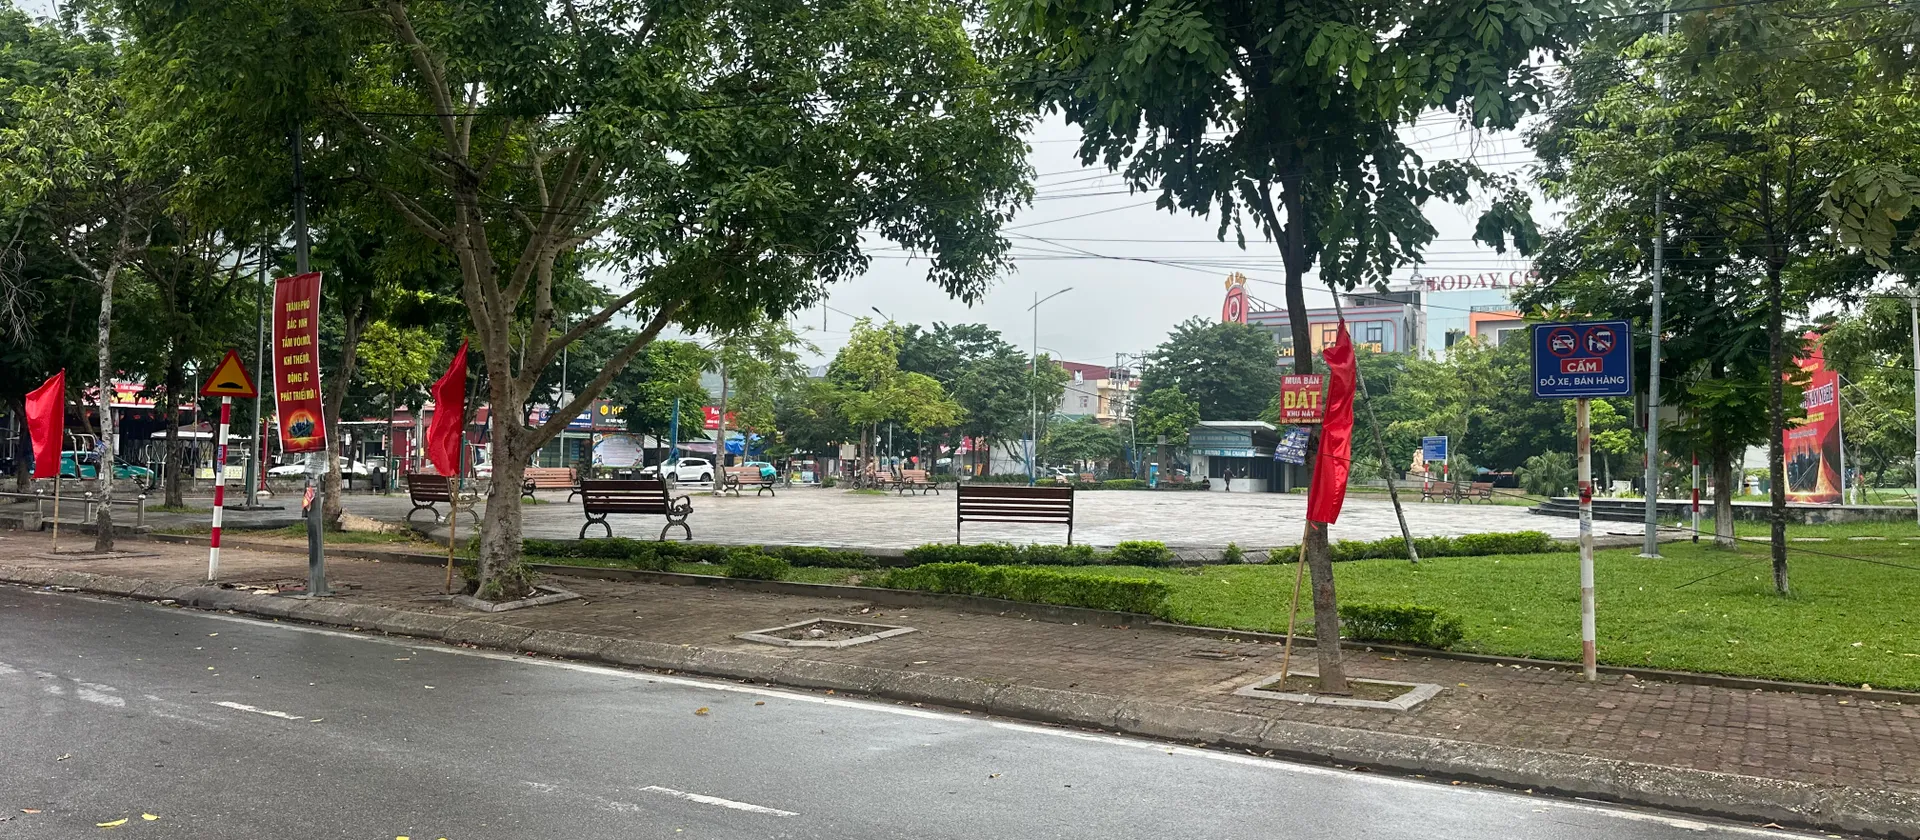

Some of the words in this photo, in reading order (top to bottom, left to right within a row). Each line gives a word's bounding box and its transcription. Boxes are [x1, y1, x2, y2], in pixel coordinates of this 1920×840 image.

[1426, 272, 1502, 291] TODAY
[1567, 359, 1597, 372] CẤM
[1284, 376, 1302, 385] MUA
[1303, 375, 1320, 385] BÁN
[1557, 377, 1572, 387] XE,
[1574, 375, 1594, 386] BÁN
[1596, 374, 1625, 385] HÀNG
[1283, 384, 1320, 409] ĐẤT
[1301, 409, 1315, 418] NÀY
